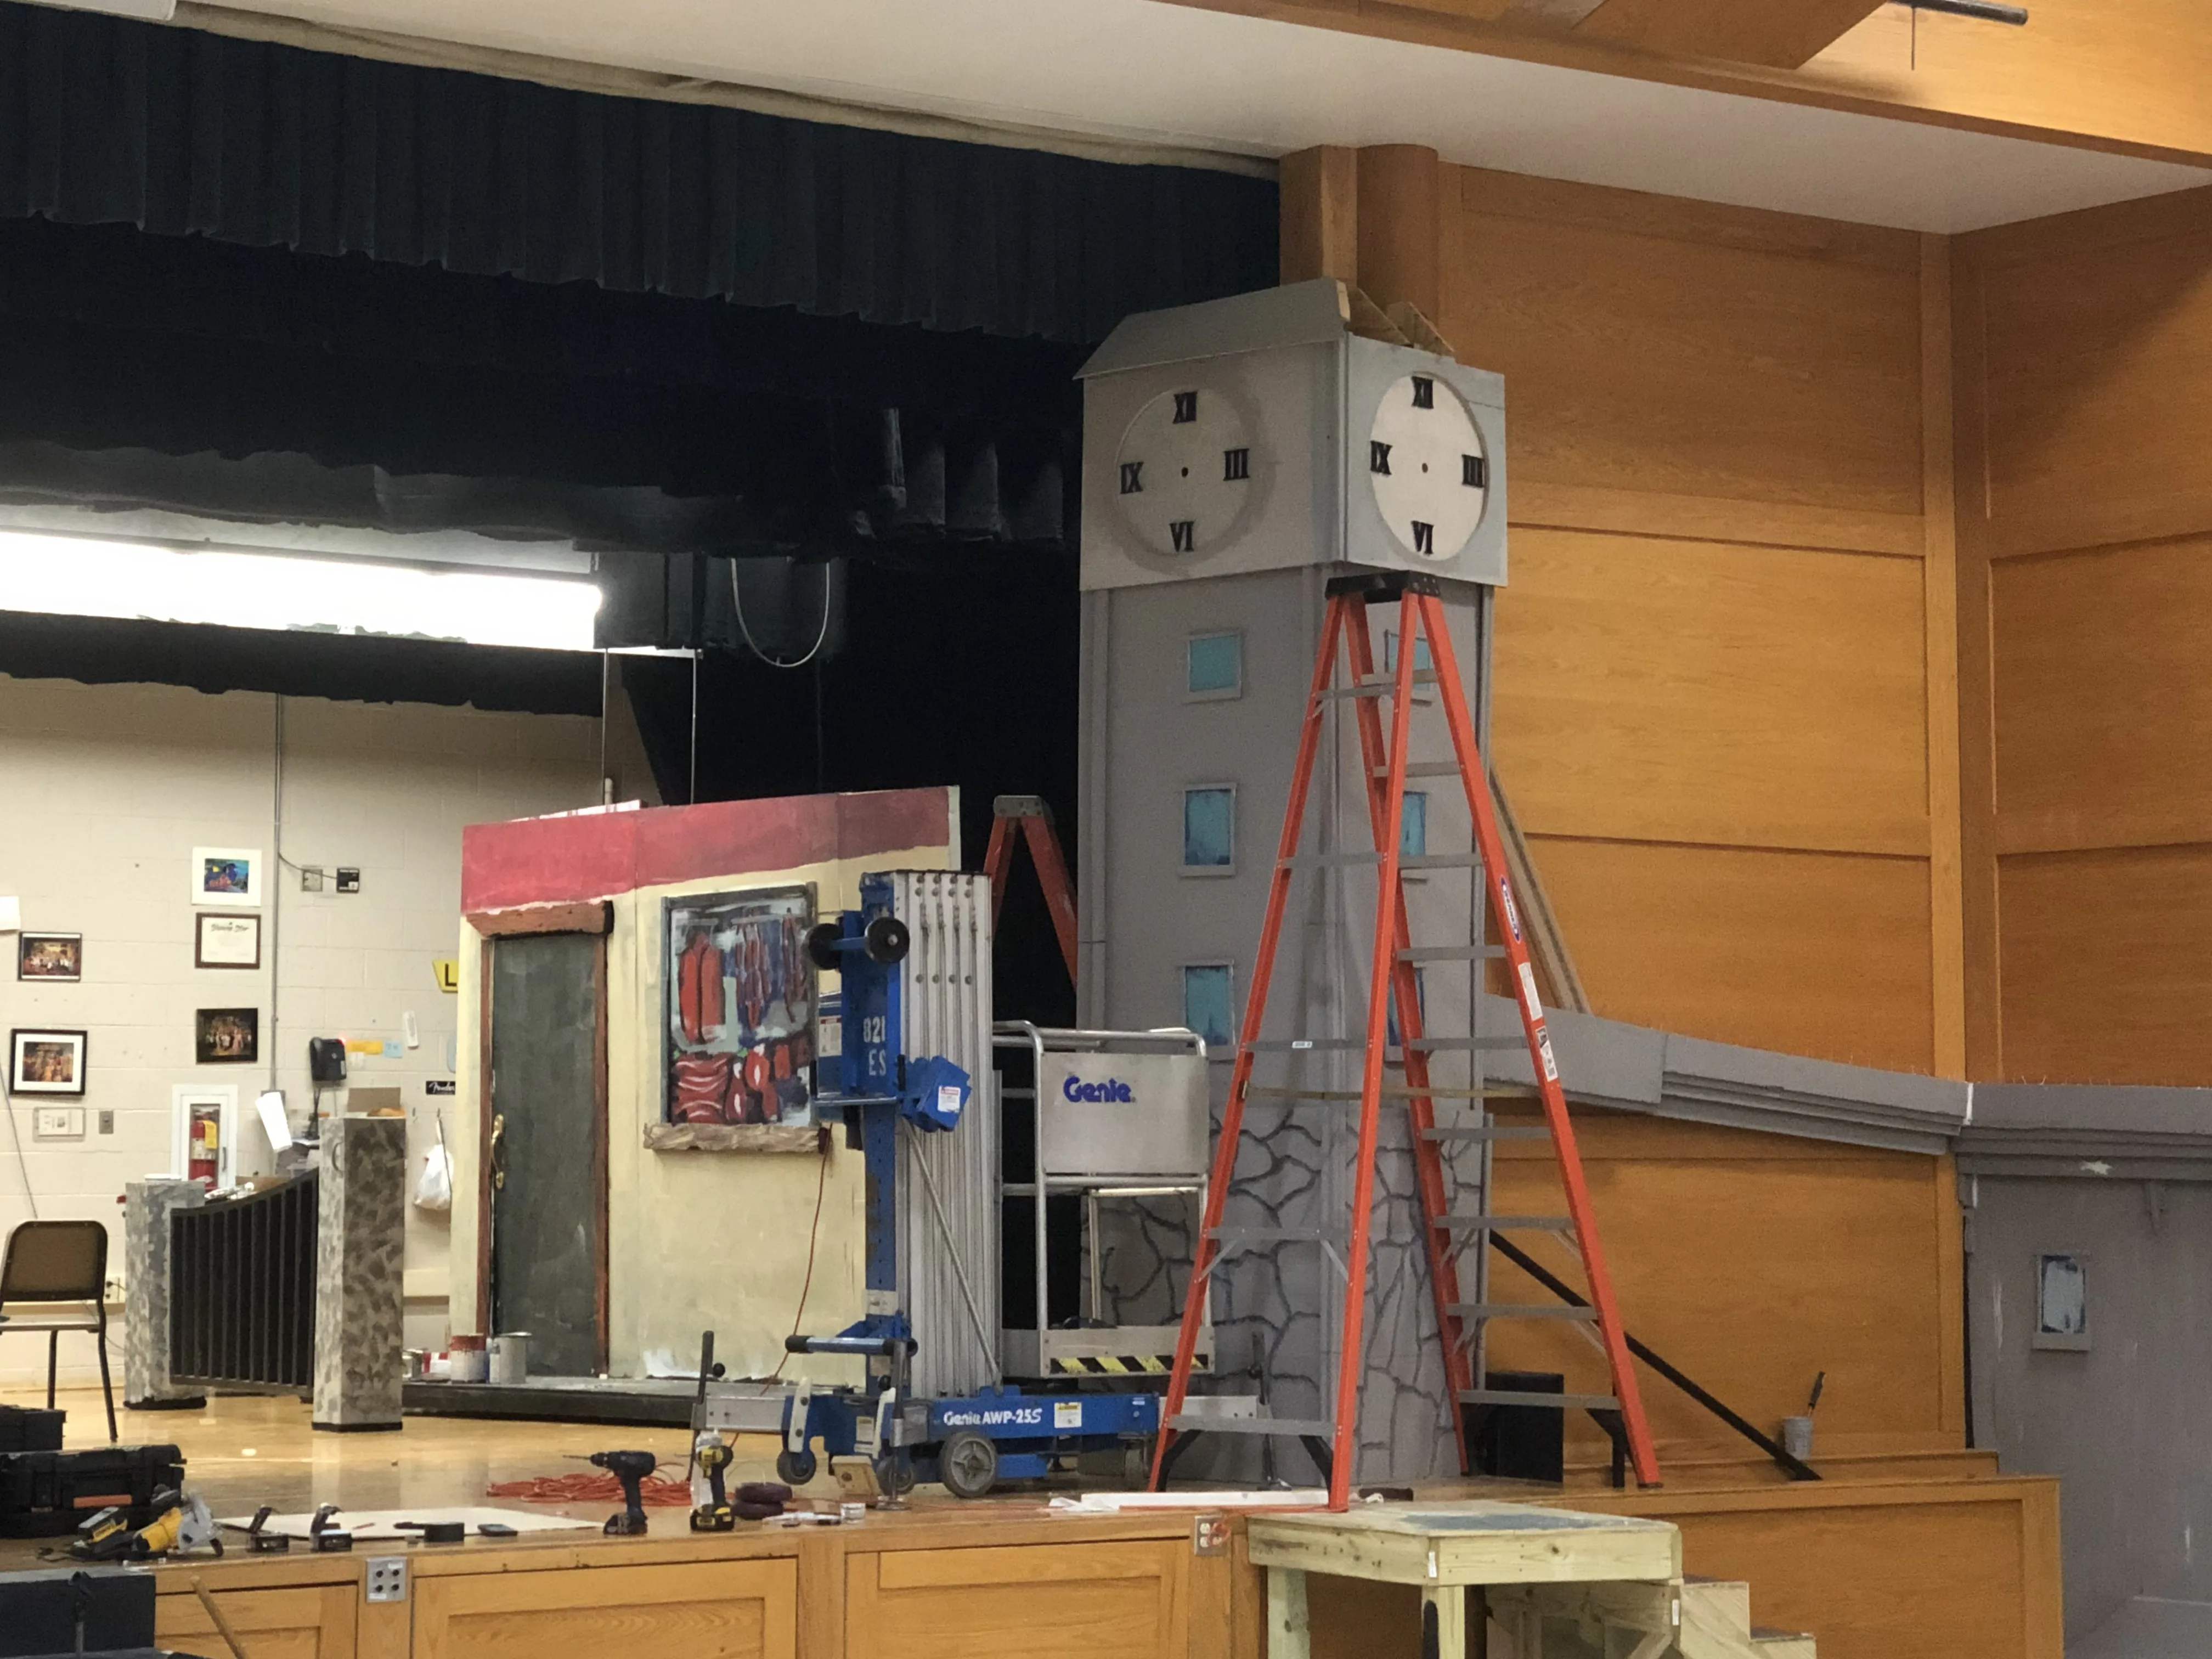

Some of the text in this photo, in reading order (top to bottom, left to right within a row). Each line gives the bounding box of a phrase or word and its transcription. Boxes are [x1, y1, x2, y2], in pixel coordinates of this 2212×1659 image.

[1172, 390, 1198, 424] XII
[1412, 375, 1434, 410] XII
[1223, 448, 1250, 481] III
[1370, 440, 1393, 475] IX
[1462, 454, 1485, 488] III
[1120, 461, 1144, 495] IX
[1170, 520, 1195, 552] VI
[1411, 520, 1434, 555] VI
[863, 1015, 886, 1043] 821
[1063, 1075, 1132, 1103] Genie
[943, 1410, 981, 1426] Genie
[982, 1408, 1043, 1425] AWP-25S
